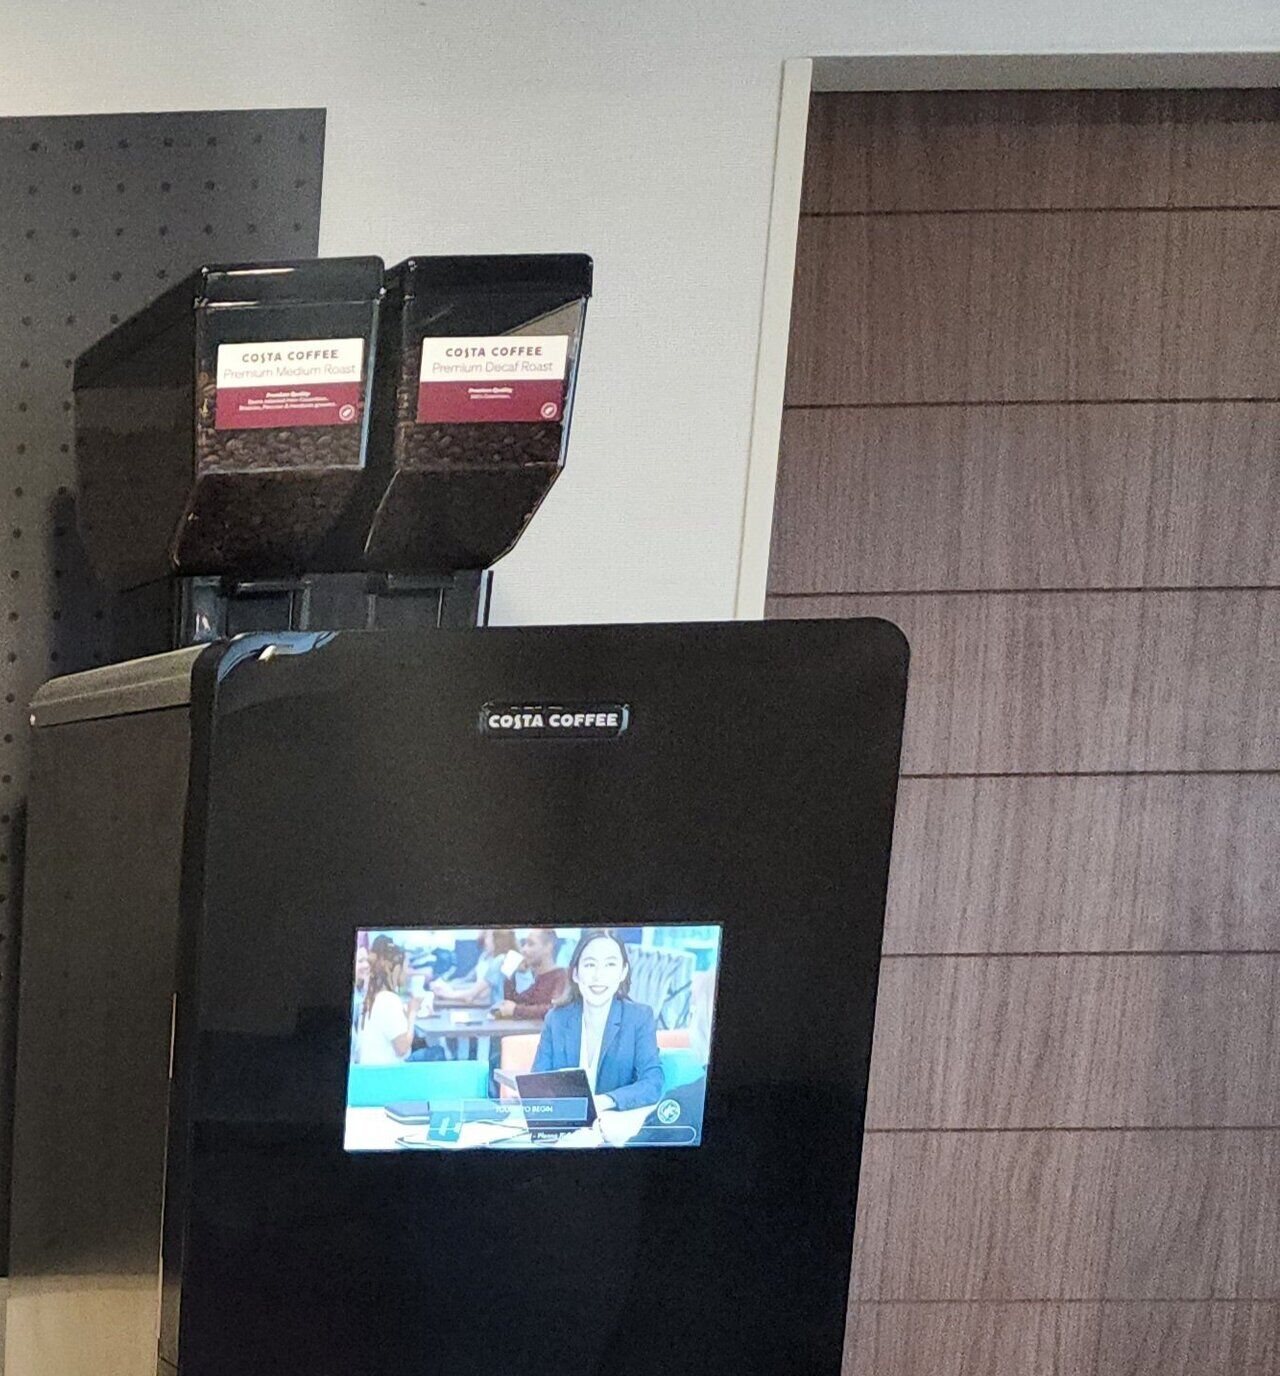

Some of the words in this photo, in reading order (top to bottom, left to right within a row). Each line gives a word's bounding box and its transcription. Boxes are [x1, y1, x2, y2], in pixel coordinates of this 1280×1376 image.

[242, 351, 282, 364] COSTA
[287, 348, 339, 361] COFFEE
[445, 347, 486, 358] COSTA
[491, 345, 543, 357] COFFEE
[223, 367, 273, 380] Premium
[275, 365, 321, 378] Medium
[323, 362, 356, 376] Roast
[432, 361, 483, 374] Premium
[485, 360, 519, 373] Decaf
[521, 360, 554, 373] Roast
[488, 713, 545, 730] COSTA
[548, 713, 619, 728] COFFEE
